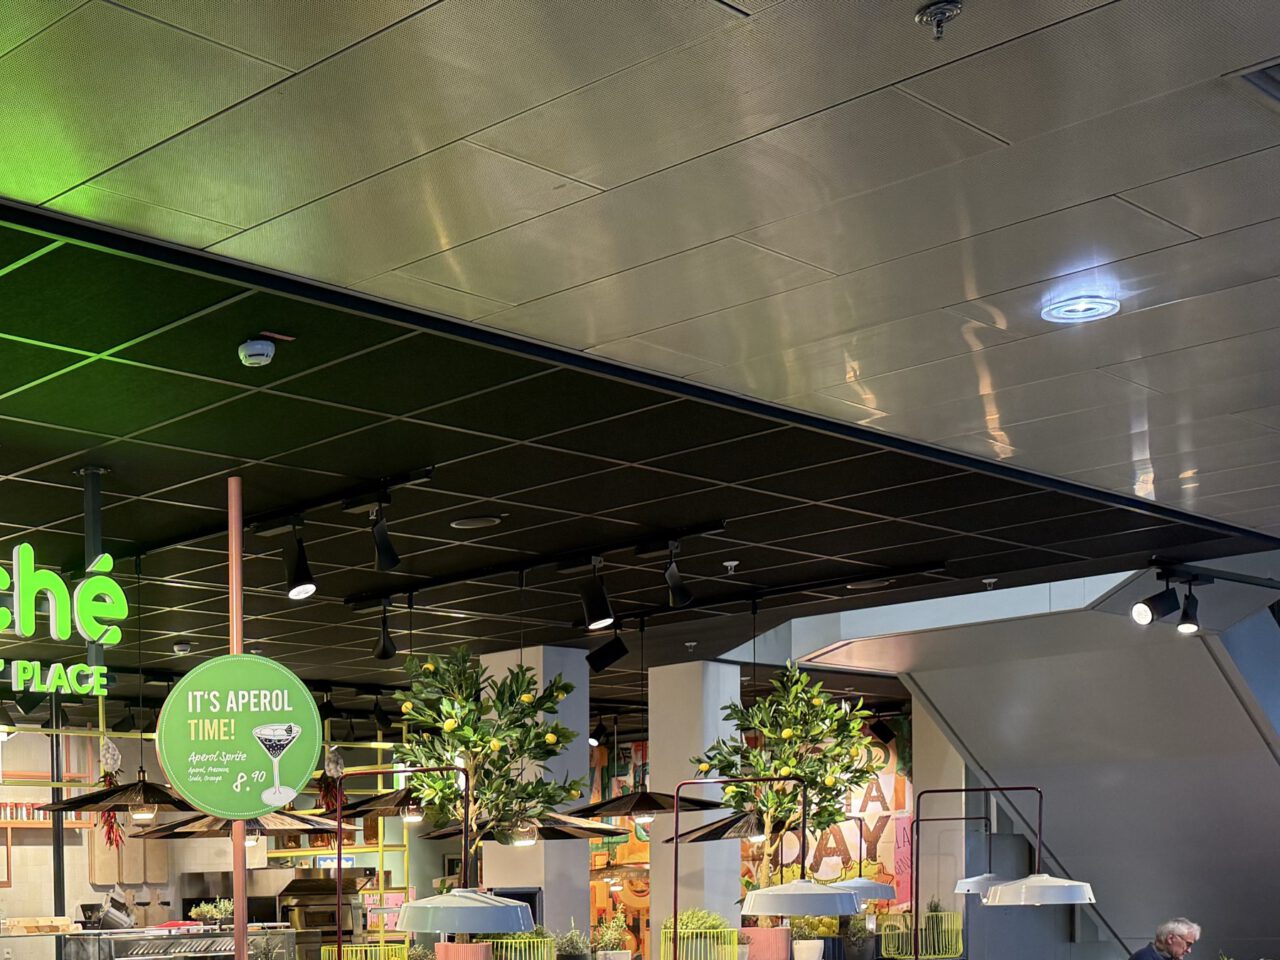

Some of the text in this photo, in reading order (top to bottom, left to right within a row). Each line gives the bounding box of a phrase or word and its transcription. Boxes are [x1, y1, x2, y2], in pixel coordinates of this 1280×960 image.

[12, 659, 109, 697] PLACE
[226, 689, 293, 712] APEROL
[187, 718, 235, 741] TIME!
[188, 751, 219, 765] Aperol
